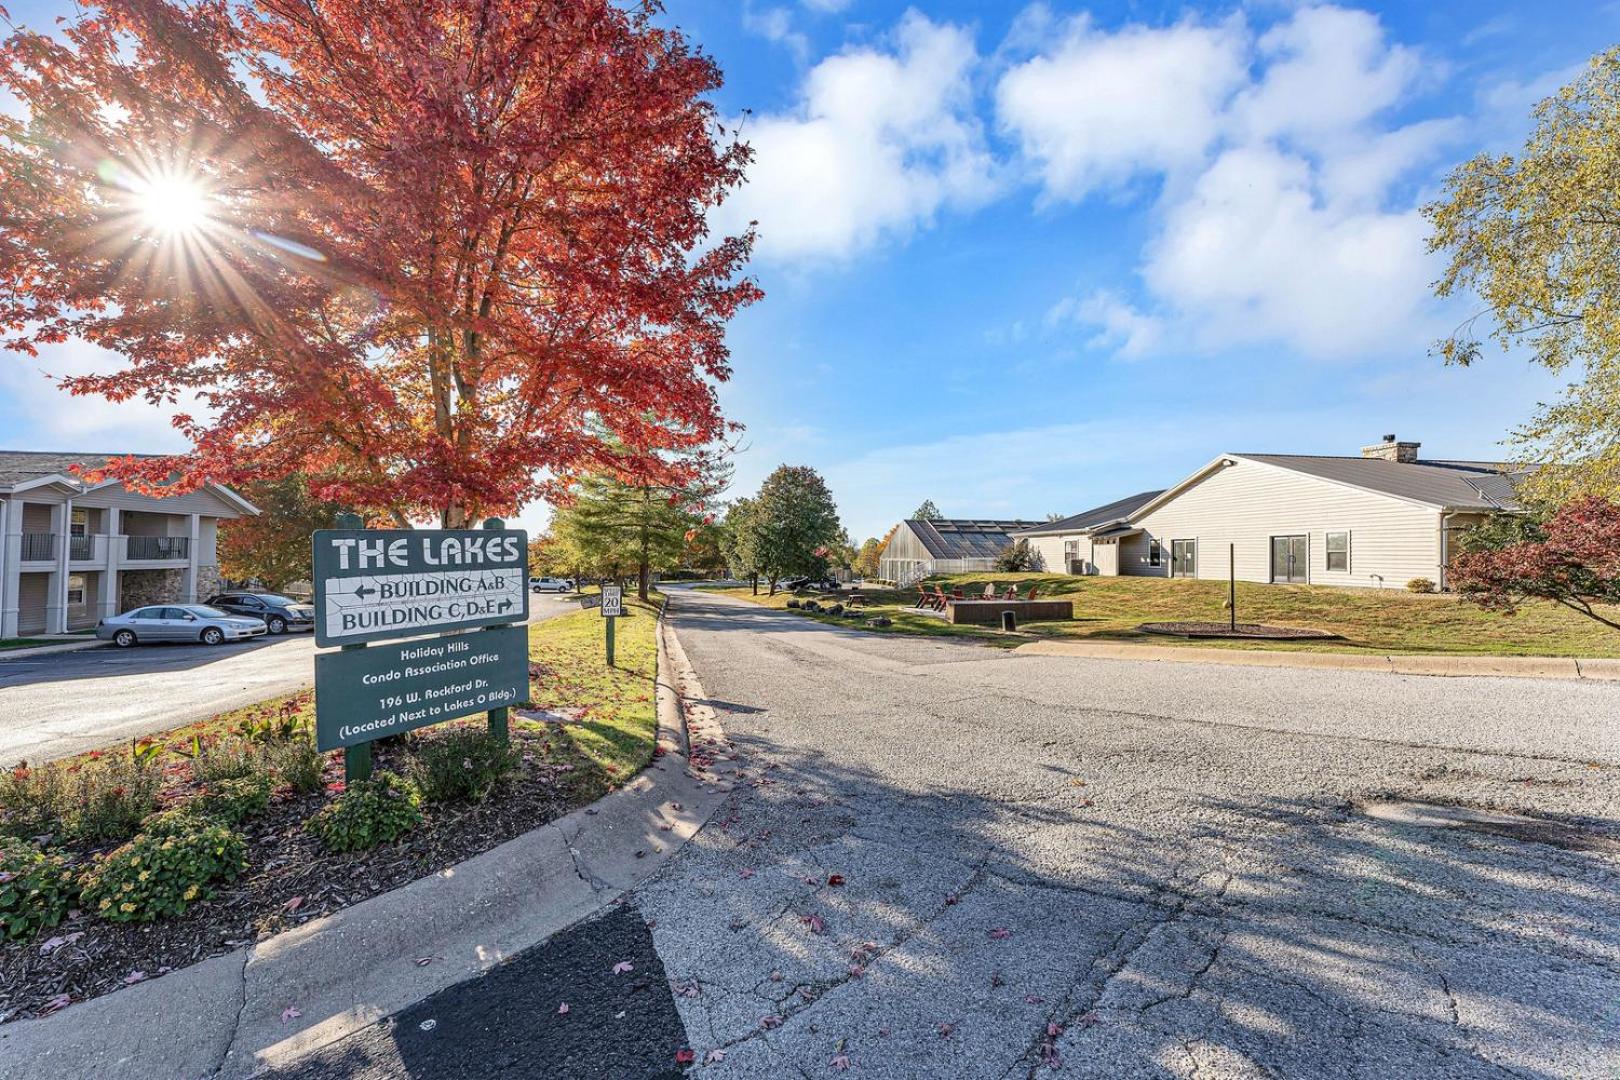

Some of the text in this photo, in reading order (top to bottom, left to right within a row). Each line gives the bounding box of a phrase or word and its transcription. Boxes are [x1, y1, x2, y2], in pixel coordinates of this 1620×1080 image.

[332, 537, 520, 569] THE LAKES
[380, 576, 505, 599] BUILDING A&B
[604, 597, 619, 607] 20
[342, 603, 442, 630] BUILDING
[400, 641, 470, 661] Holiday Hills
[362, 653, 499, 685] Condo Association Office
[379, 679, 488, 710] 196 W. Rockford Dr.
[339, 687, 517, 740] (Located Next to Lakes O Bldg.)
